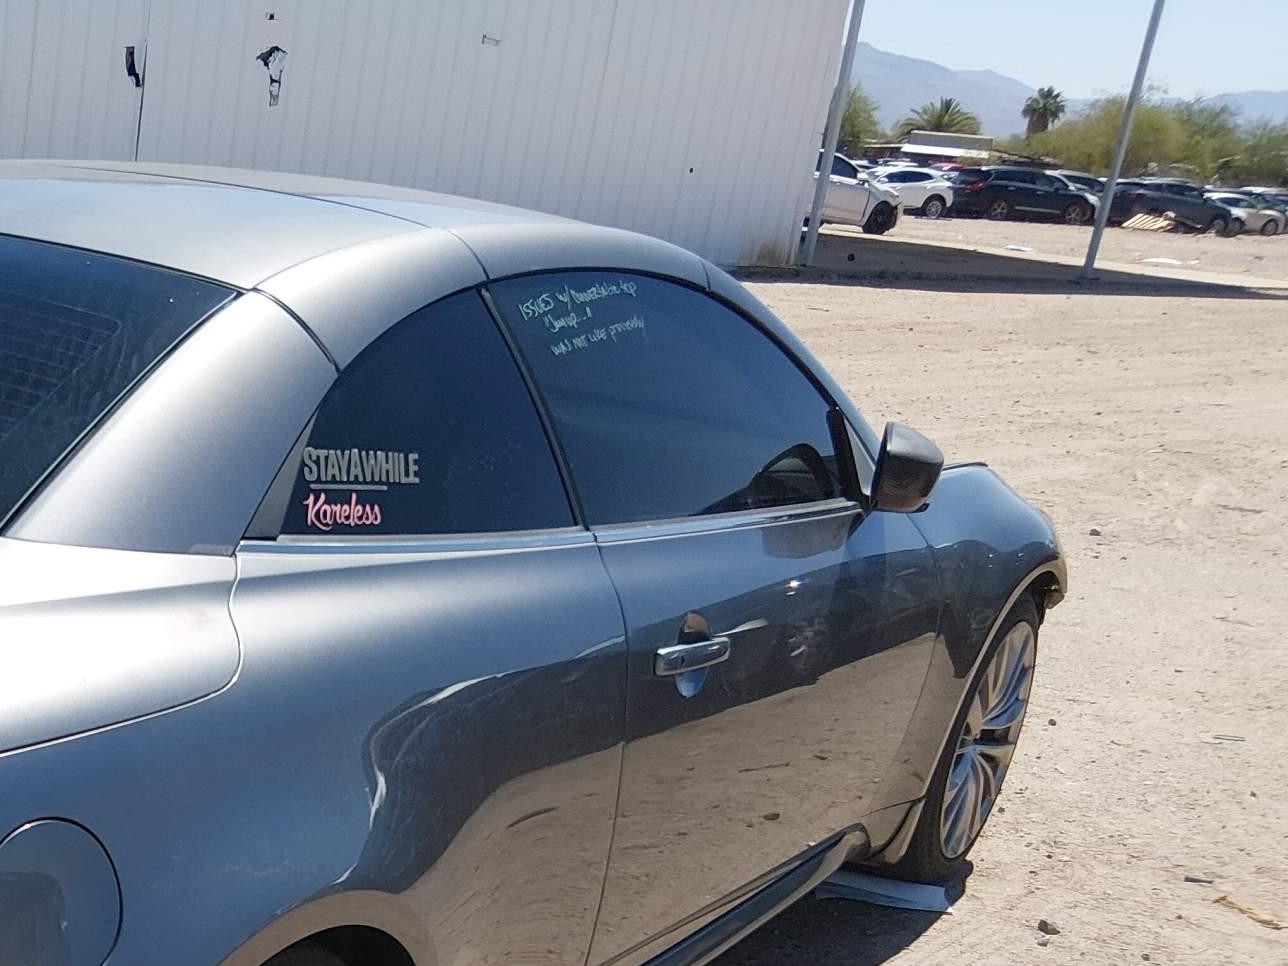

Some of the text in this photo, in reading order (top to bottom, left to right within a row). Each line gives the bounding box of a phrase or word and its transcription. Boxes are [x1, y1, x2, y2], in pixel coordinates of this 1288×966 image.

[518, 293, 554, 320] ISSUES
[550, 339, 572, 356] WAS
[303, 446, 420, 484] STAYAWHILE
[303, 492, 382, 531] Kareless
